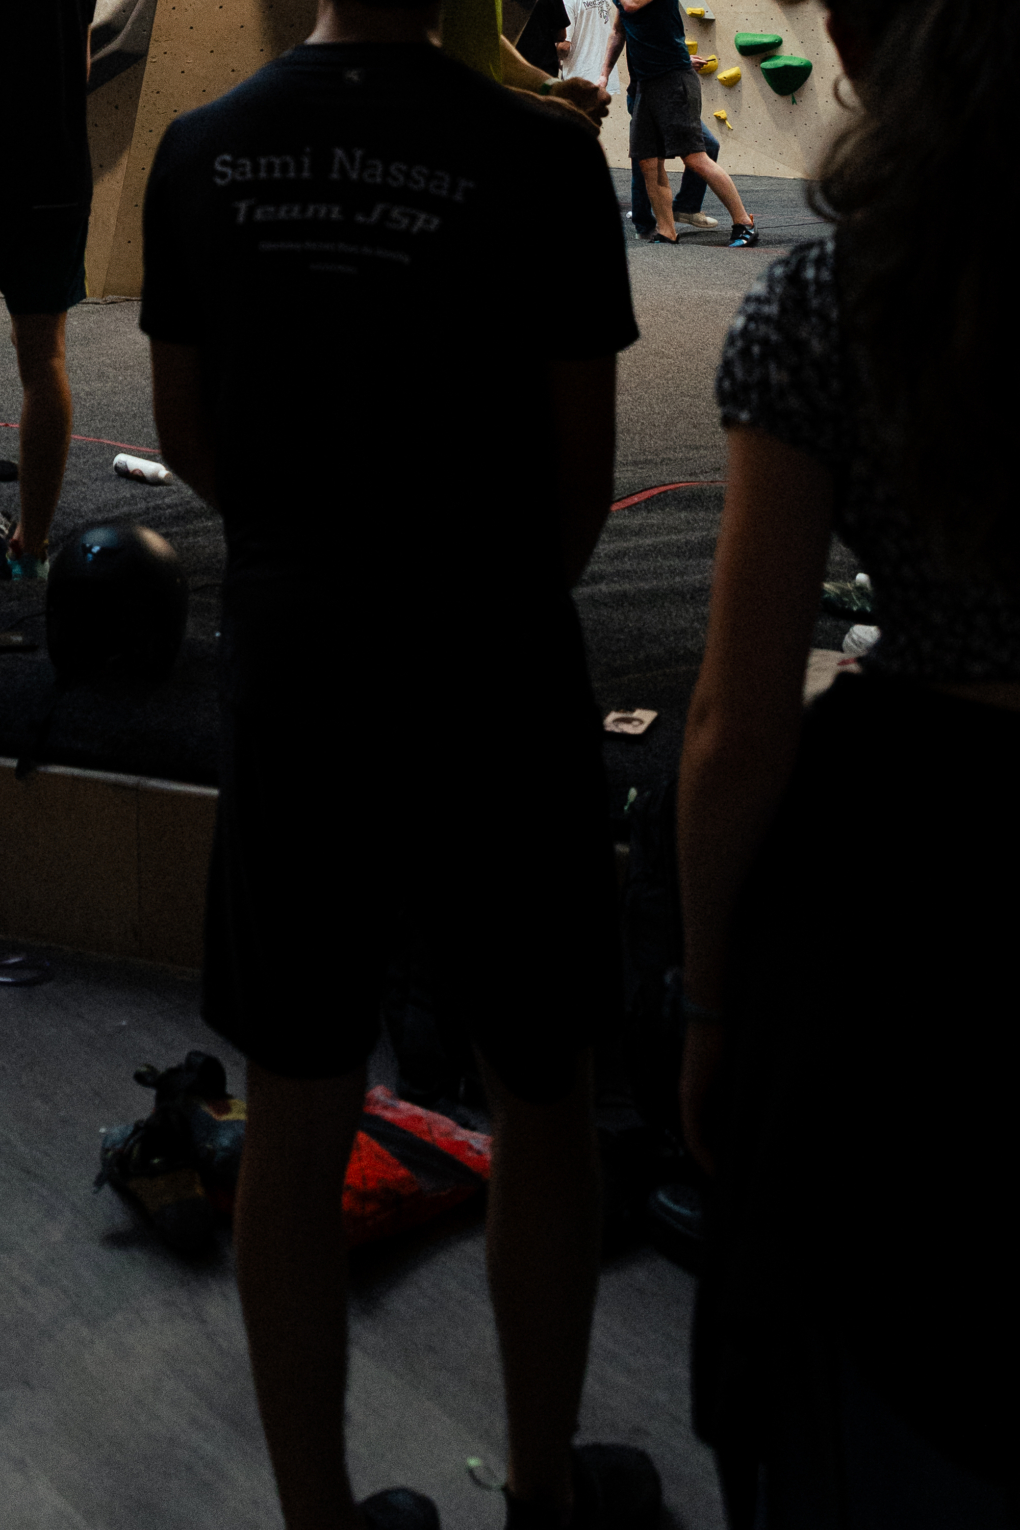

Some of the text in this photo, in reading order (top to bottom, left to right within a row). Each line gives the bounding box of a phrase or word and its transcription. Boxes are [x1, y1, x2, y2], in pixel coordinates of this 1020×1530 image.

[212, 146, 477, 204] Sami Nassar
[231, 197, 346, 226] Team
